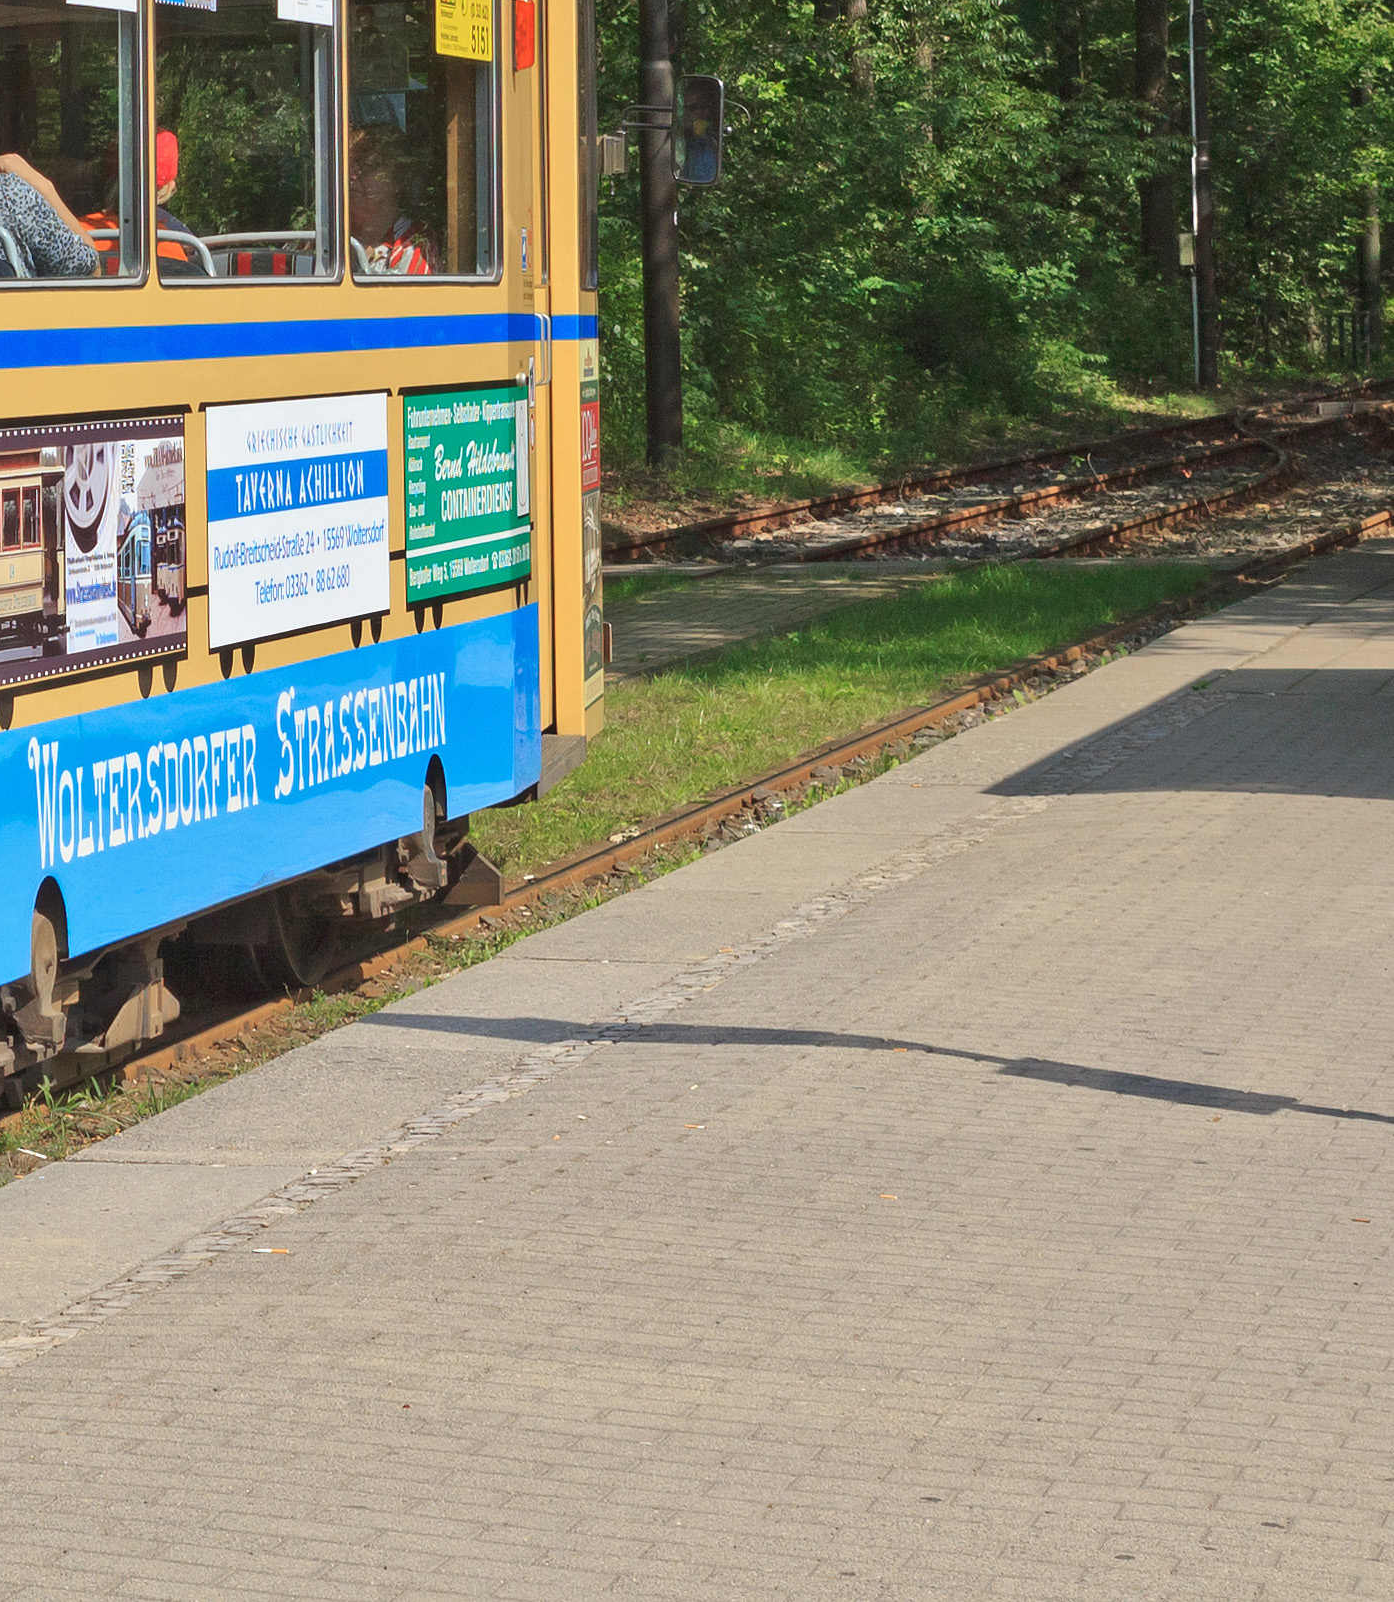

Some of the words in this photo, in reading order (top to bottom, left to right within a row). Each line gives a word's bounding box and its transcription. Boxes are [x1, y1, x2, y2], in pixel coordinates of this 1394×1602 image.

[471, 24, 489, 55] 5151
[246, 426, 298, 453] GRIECHISCHE
[301, 421, 353, 448] GASTLICHKEIT
[434, 443, 463, 482] Bernd
[235, 468, 293, 513] TAVERNA
[299, 459, 365, 505] ACHILLION
[441, 481, 513, 522] CONTAINERDIENST
[213, 531, 305, 571] Rudolf-Breitscheid-Straße
[323, 525, 345, 552] 15569
[345, 519, 385, 547] Woltersdorf
[255, 577, 285, 605] Telefon:
[285, 571, 309, 598] 03362
[27, 723, 259, 870] WOLTERSDORFER
[273, 671, 446, 800] STRASSENBAHN
